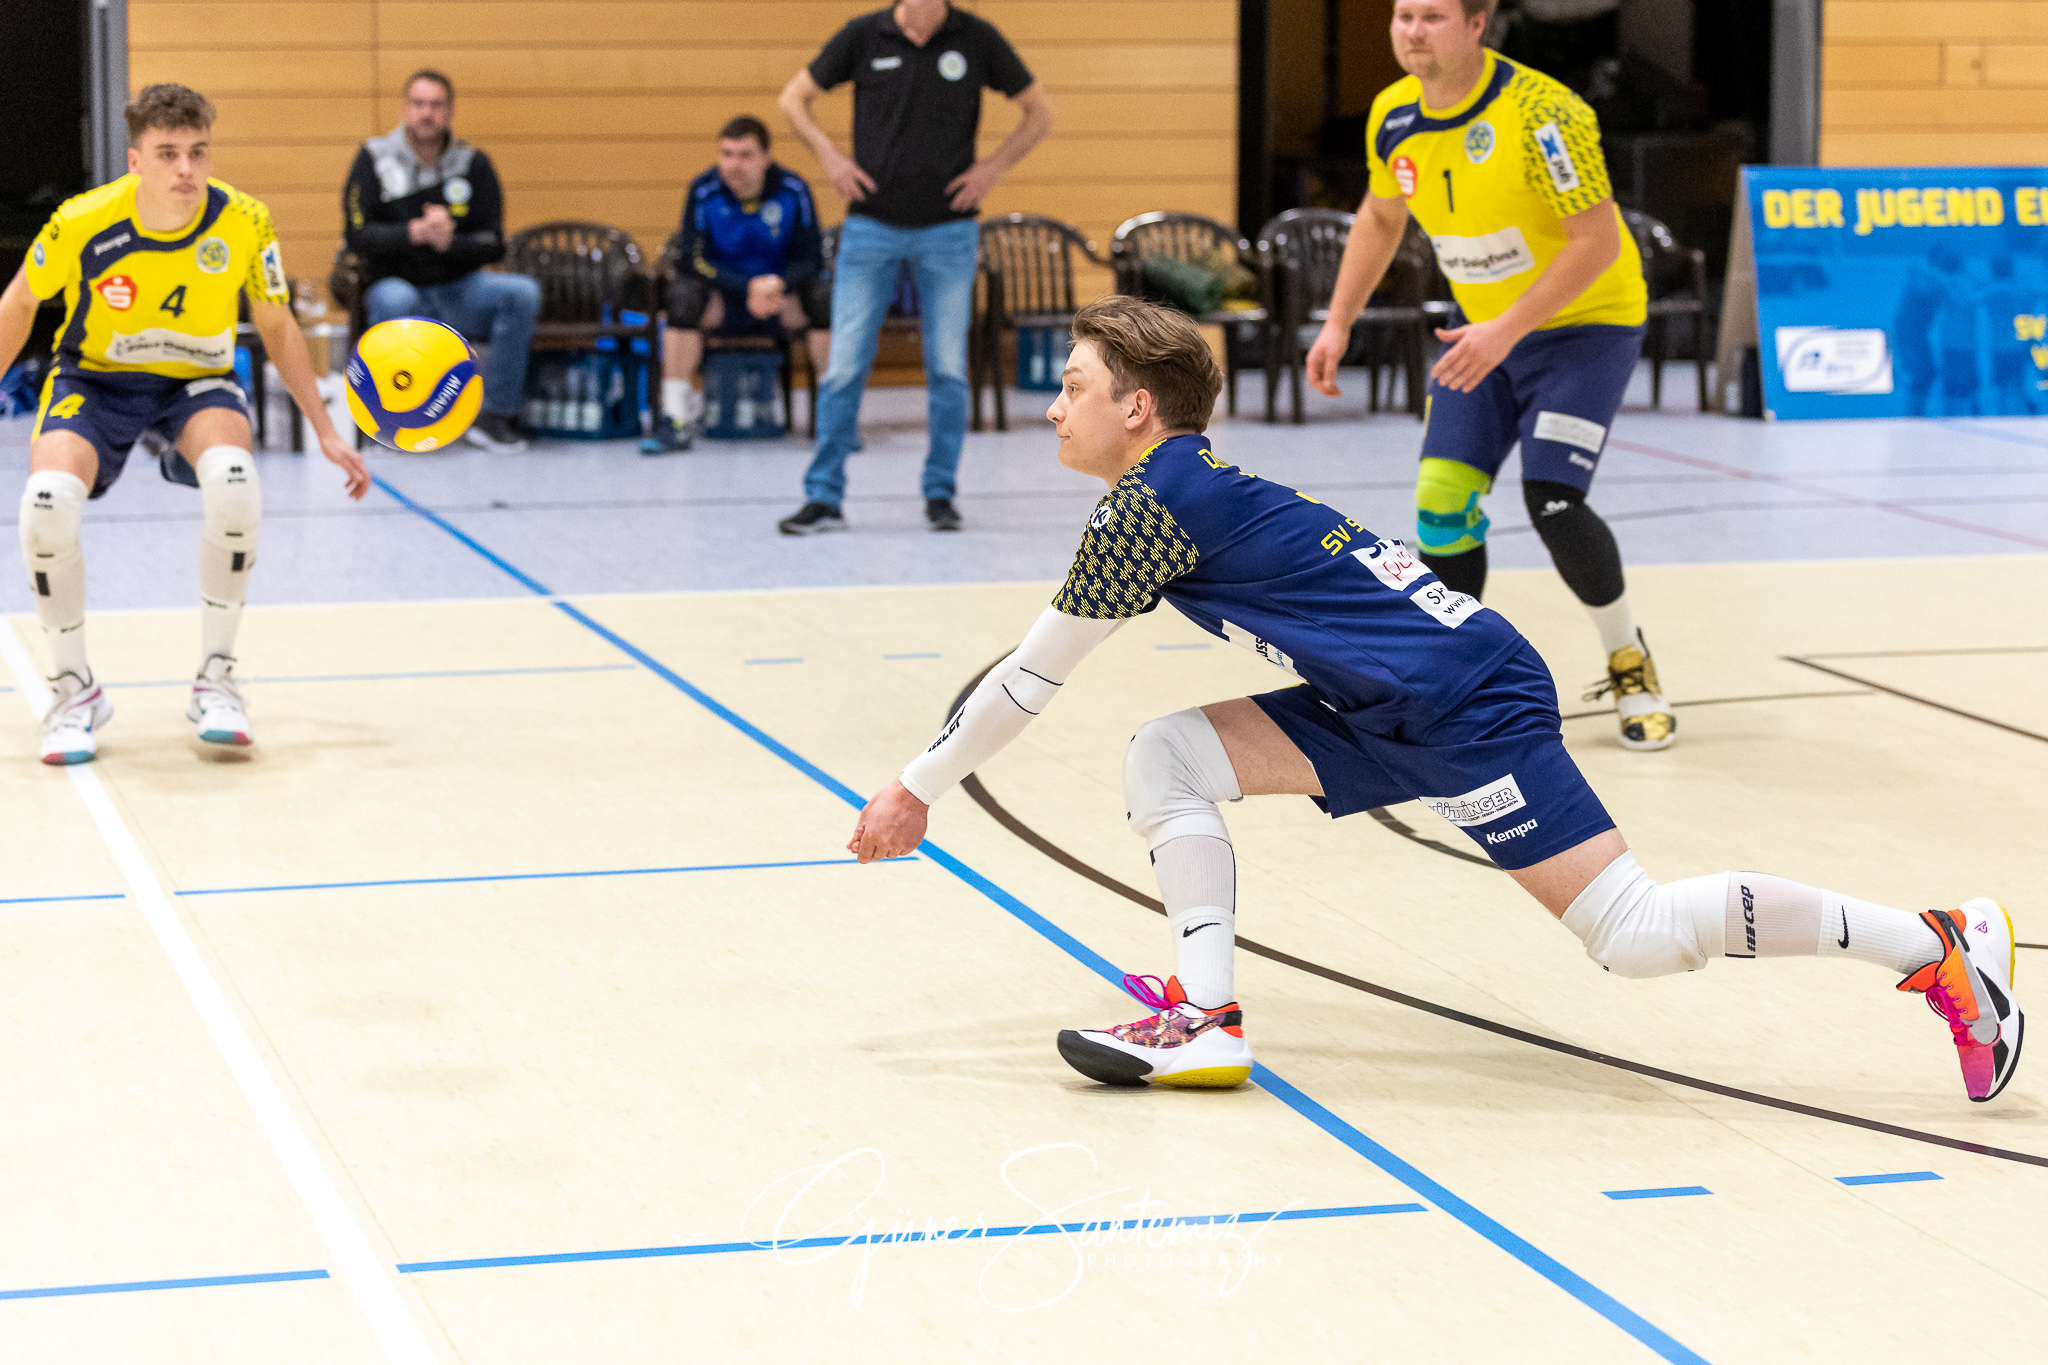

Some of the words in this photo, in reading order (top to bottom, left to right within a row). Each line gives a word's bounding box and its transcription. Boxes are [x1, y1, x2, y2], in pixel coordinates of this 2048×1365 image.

[1443, 169, 1454, 214] 1
[1763, 188, 1845, 228] DER
[1854, 187, 2004, 236] JUGEND
[160, 285, 187, 318] 4
[50, 393, 85, 419] 4
[1321, 525, 1351, 556] SV
[1485, 818, 1539, 845] Kempa
